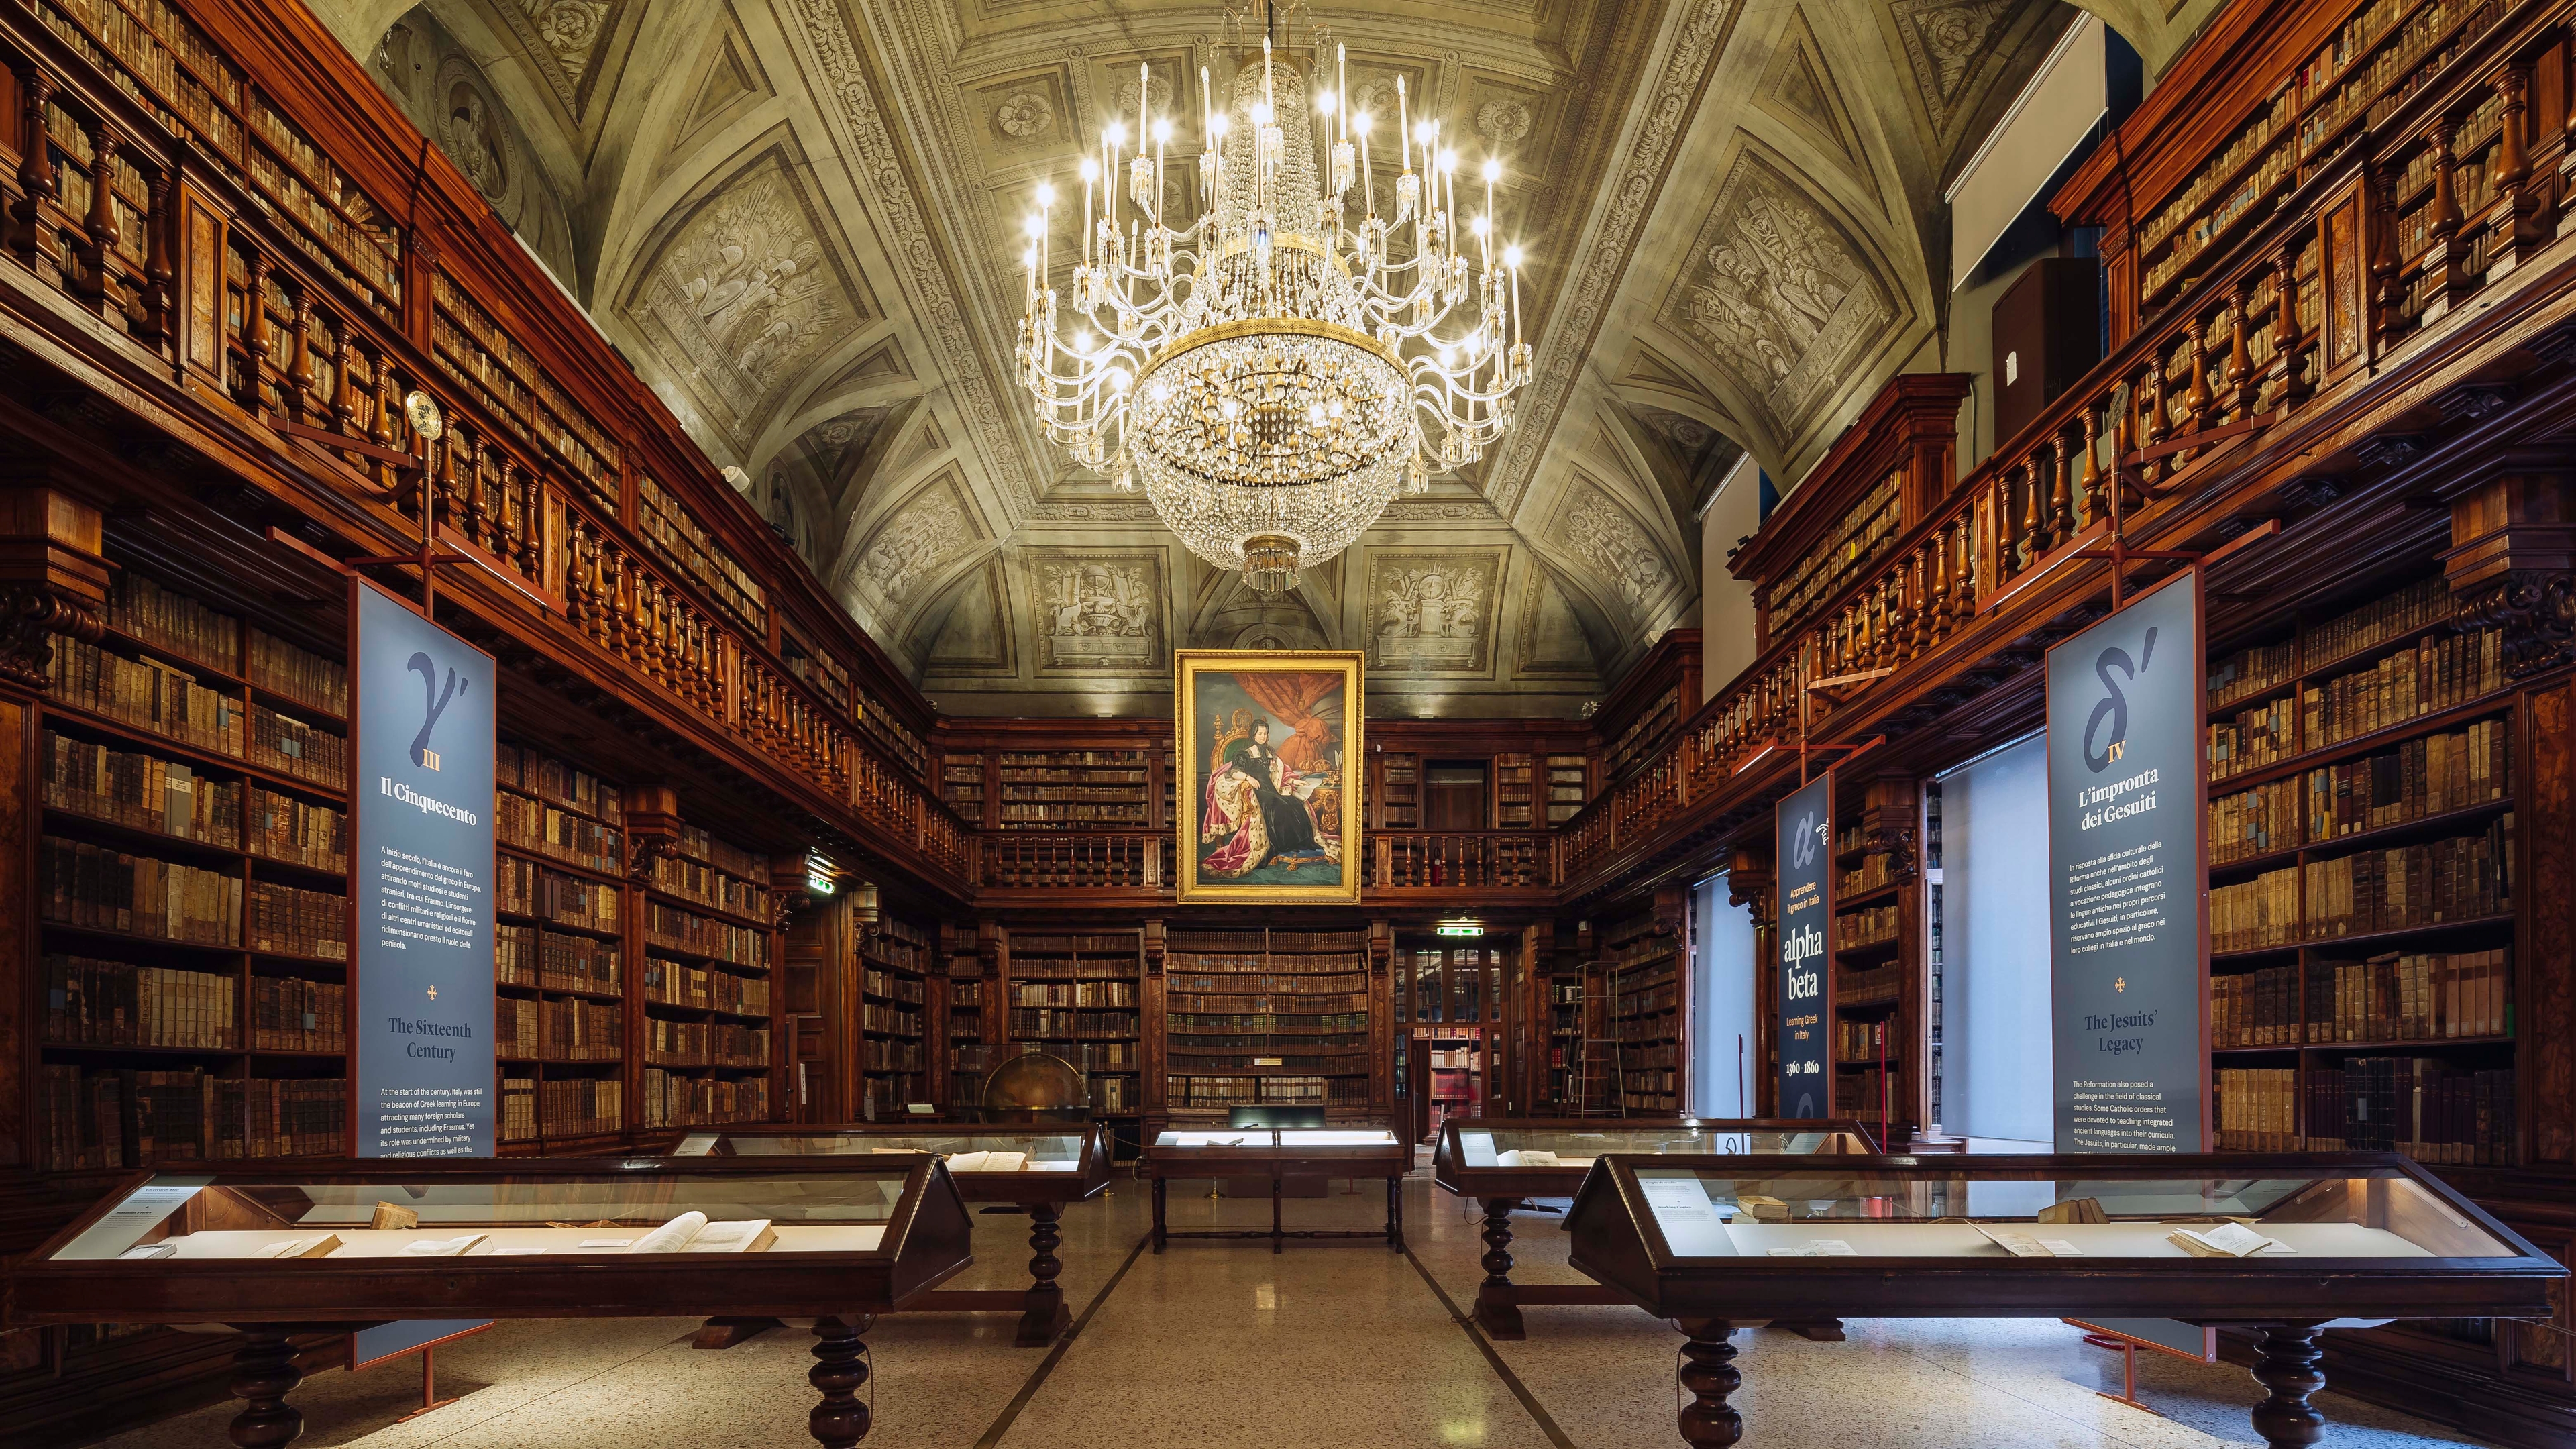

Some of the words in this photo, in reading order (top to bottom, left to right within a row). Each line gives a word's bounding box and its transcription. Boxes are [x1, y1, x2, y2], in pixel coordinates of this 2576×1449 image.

[423, 748, 441, 772] III
[2108, 740, 2126, 763] IV
[2079, 769, 2159, 808] L'impronta
[381, 777, 392, 796] Il
[394, 783, 476, 826] Cinquecento
[2082, 808, 2102, 830] dei
[2104, 790, 2157, 822] Gesuiti
[386, 847, 401, 858] inizio
[402, 853, 421, 865] secolo,
[422, 857, 437, 868] l'Italia
[442, 865, 459, 874] ancora
[464, 869, 473, 878] faro
[2076, 859, 2096, 870] risposta
[2097, 856, 2106, 864] alla
[2107, 852, 2121, 861] sfida
[2121, 845, 2147, 857] culturale
[2147, 841, 2161, 851] della
[381, 859, 433, 879] dell'apprendimento
[434, 873, 443, 882] del
[443, 877, 458, 886] greco
[458, 879, 463, 888] in
[464, 881, 481, 893] Europa,
[2070, 873, 2090, 883] Riforma
[2090, 869, 2106, 878] anche
[2108, 861, 2138, 873] nell'ambito
[2139, 855, 2153, 865] degli
[2070, 885, 2083, 895] studi
[2084, 881, 2104, 892] classici,
[2105, 876, 2121, 887] alcuni
[2122, 871, 2139, 883] ordini
[2139, 865, 2163, 878] cattolici
[381, 873, 407, 885] attirando
[408, 881, 422, 889] molti
[423, 884, 443, 894] studiosi
[448, 890, 468, 900] studenti
[1790, 881, 1817, 899] Apprendere
[2074, 895, 2100, 906] vocazione
[2101, 888, 2133, 902] pedagogica
[2134, 881, 2162, 892] integrano
[381, 887, 405, 898] stranieri,
[407, 892, 415, 900] tra
[425, 896, 445, 907] Erasmo.
[445, 900, 472, 913] L'insorgere
[1787, 904, 1790, 914] il
[1790, 902, 1803, 915] greco
[1803, 900, 1808, 908] in
[1808, 894, 1819, 906] Italia
[2076, 910, 2091, 918] lingue
[2092, 904, 2112, 914] antiche
[2112, 901, 2121, 910] nei
[2123, 897, 2140, 910] propri
[2141, 892, 2165, 906] percorsi
[382, 925, 423, 940] ridimensionano
[424, 934, 441, 943] presto
[460, 940, 471, 949] della
[2071, 933, 2094, 942] riservano
[2095, 928, 2112, 938] ampio
[2112, 925, 2131, 936] spazio
[2131, 923, 2137, 931] al
[2138, 922, 2155, 932] greco
[2156, 918, 2165, 926] nei
[382, 940, 406, 949] penisola.
[1784, 924, 1823, 969] alpha
[1788, 967, 1819, 1000] beta
[388, 1017, 413, 1034] The
[416, 1019, 471, 1038] Sixteenth
[1786, 1017, 1804, 1028] Learning
[1805, 1014, 1818, 1024] Greek
[2084, 1014, 2108, 1030] The
[2110, 1009, 2157, 1032] Jesuits'
[1794, 1030, 1799, 1040] in
[1799, 1030, 1809, 1042] Italy
[2099, 1037, 2143, 1055] Legacy
[407, 1042, 456, 1063] Century
[1786, 1060, 1800, 1077] 1360
[1803, 1060, 1819, 1074] 1860
[430, 1089, 451, 1097] century,
[452, 1088, 462, 1097] Italy
[2130, 1081, 2148, 1089] posed
[437, 1099, 457, 1109] learning
[463, 1099, 480, 1108] Europe,
[2073, 1093, 2098, 1102] challenge
[2110, 1104, 2133, 1112] Catholic
[2134, 1105, 2153, 1113] orders
[2154, 1106, 2166, 1114] that
[380, 1113, 409, 1122] attracting
[425, 1112, 443, 1121] foreign
[2117, 1118, 2141, 1127] teaching
[2142, 1118, 2173, 1128] integrated
[380, 1126, 392, 1134] and
[392, 1126, 418, 1134] students,
[419, 1124, 443, 1133] including
[2094, 1128, 2121, 1138] languages
[2121, 1129, 2133, 1137] into
[2148, 1131, 2176, 1139] curricula.
